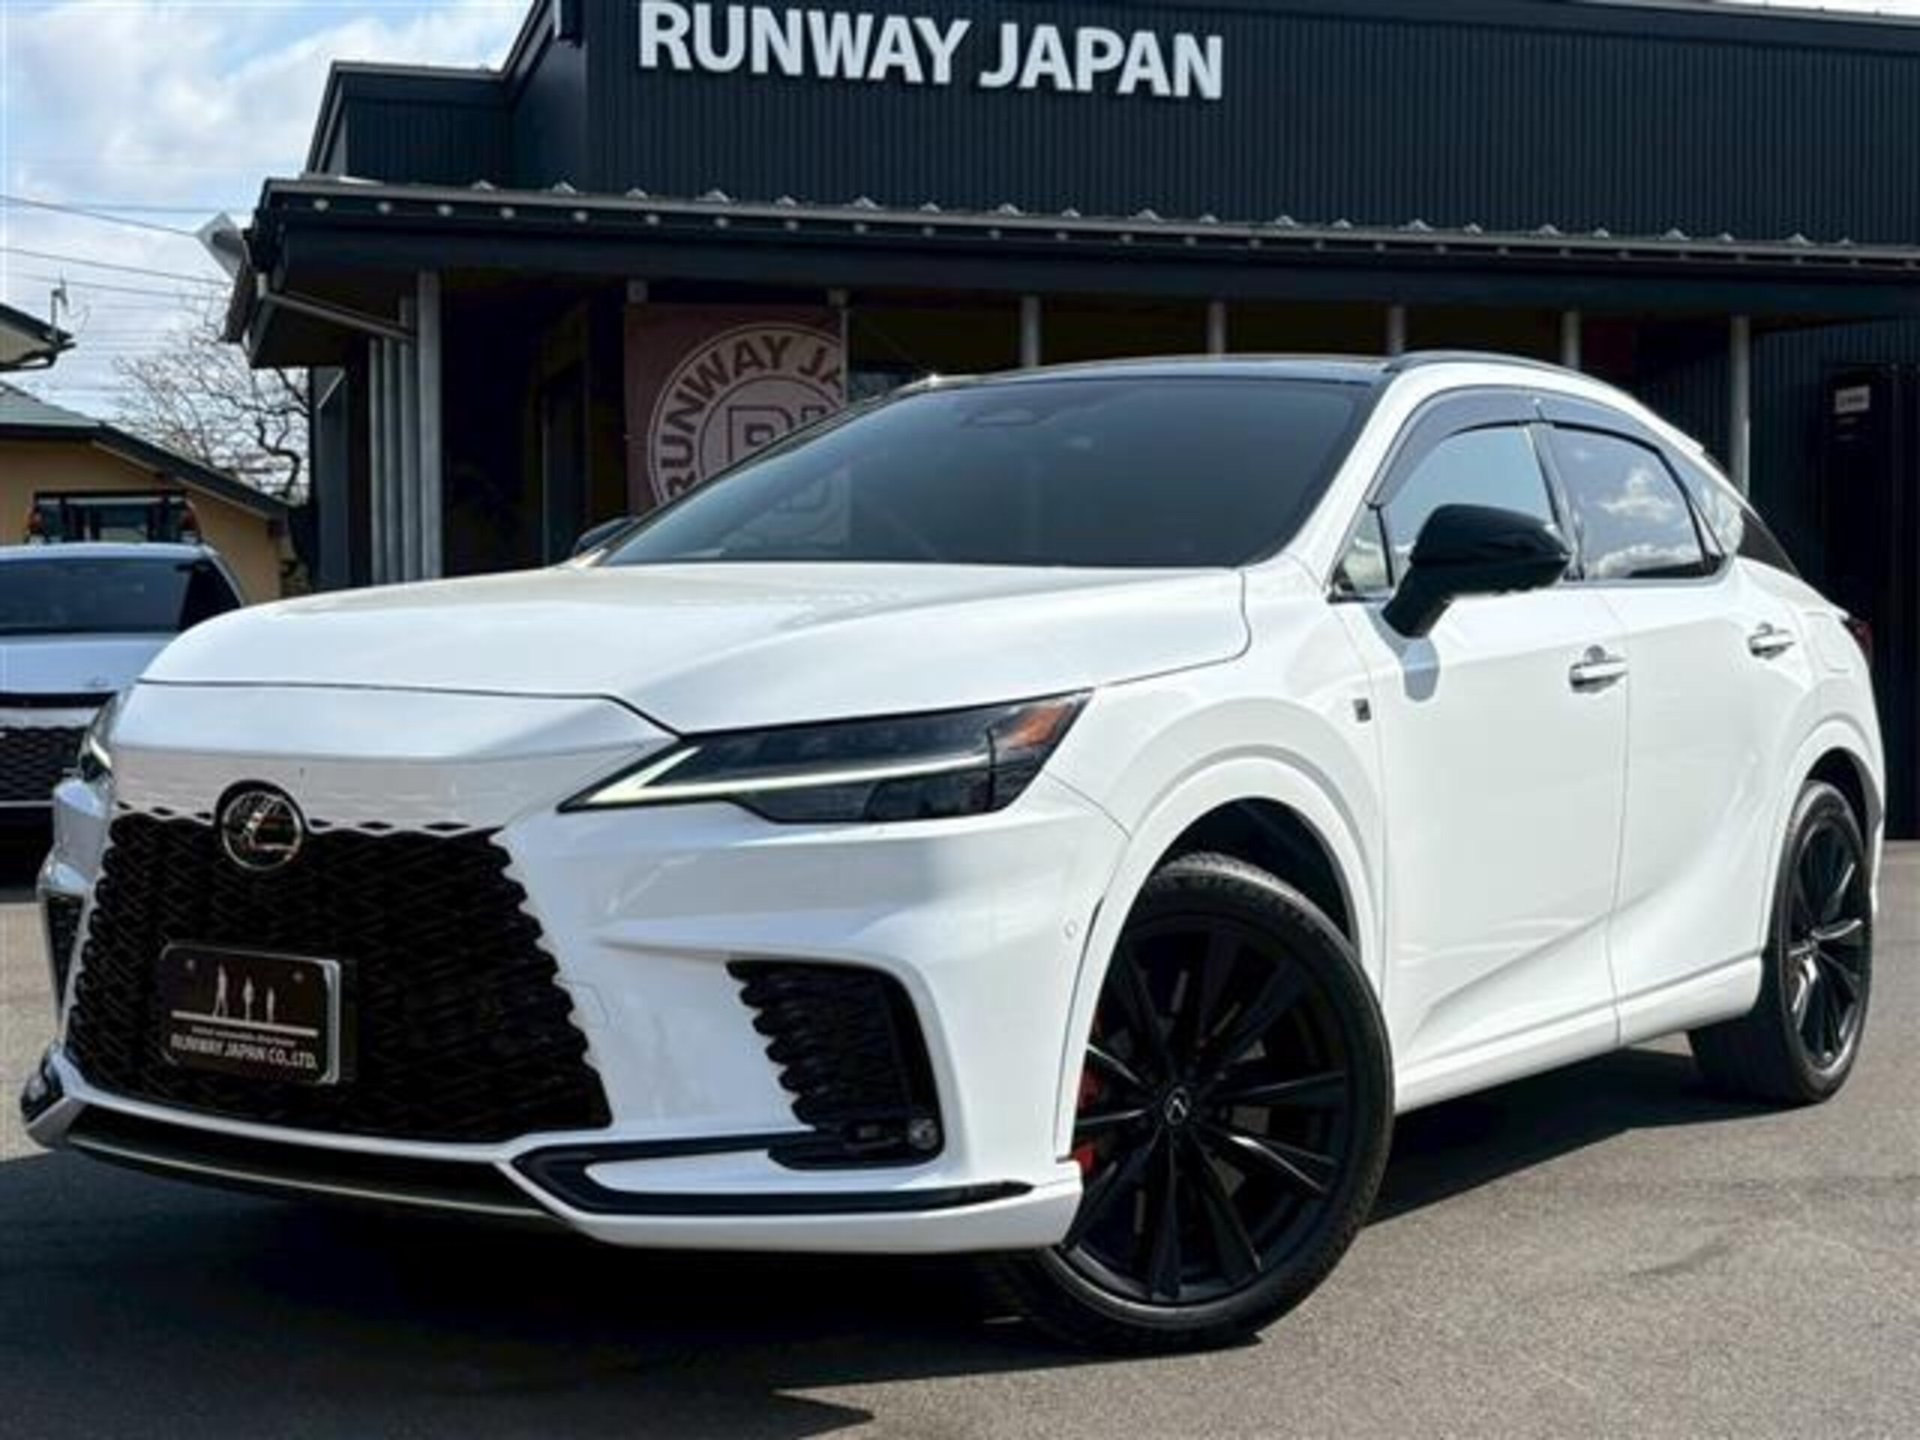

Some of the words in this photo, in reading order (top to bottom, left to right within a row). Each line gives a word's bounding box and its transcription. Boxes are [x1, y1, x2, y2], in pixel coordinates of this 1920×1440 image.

[640, 0, 970, 84] RUNWAY
[979, 23, 1223, 99] JAPAN
[224, 1042, 265, 1062] JAPAN
